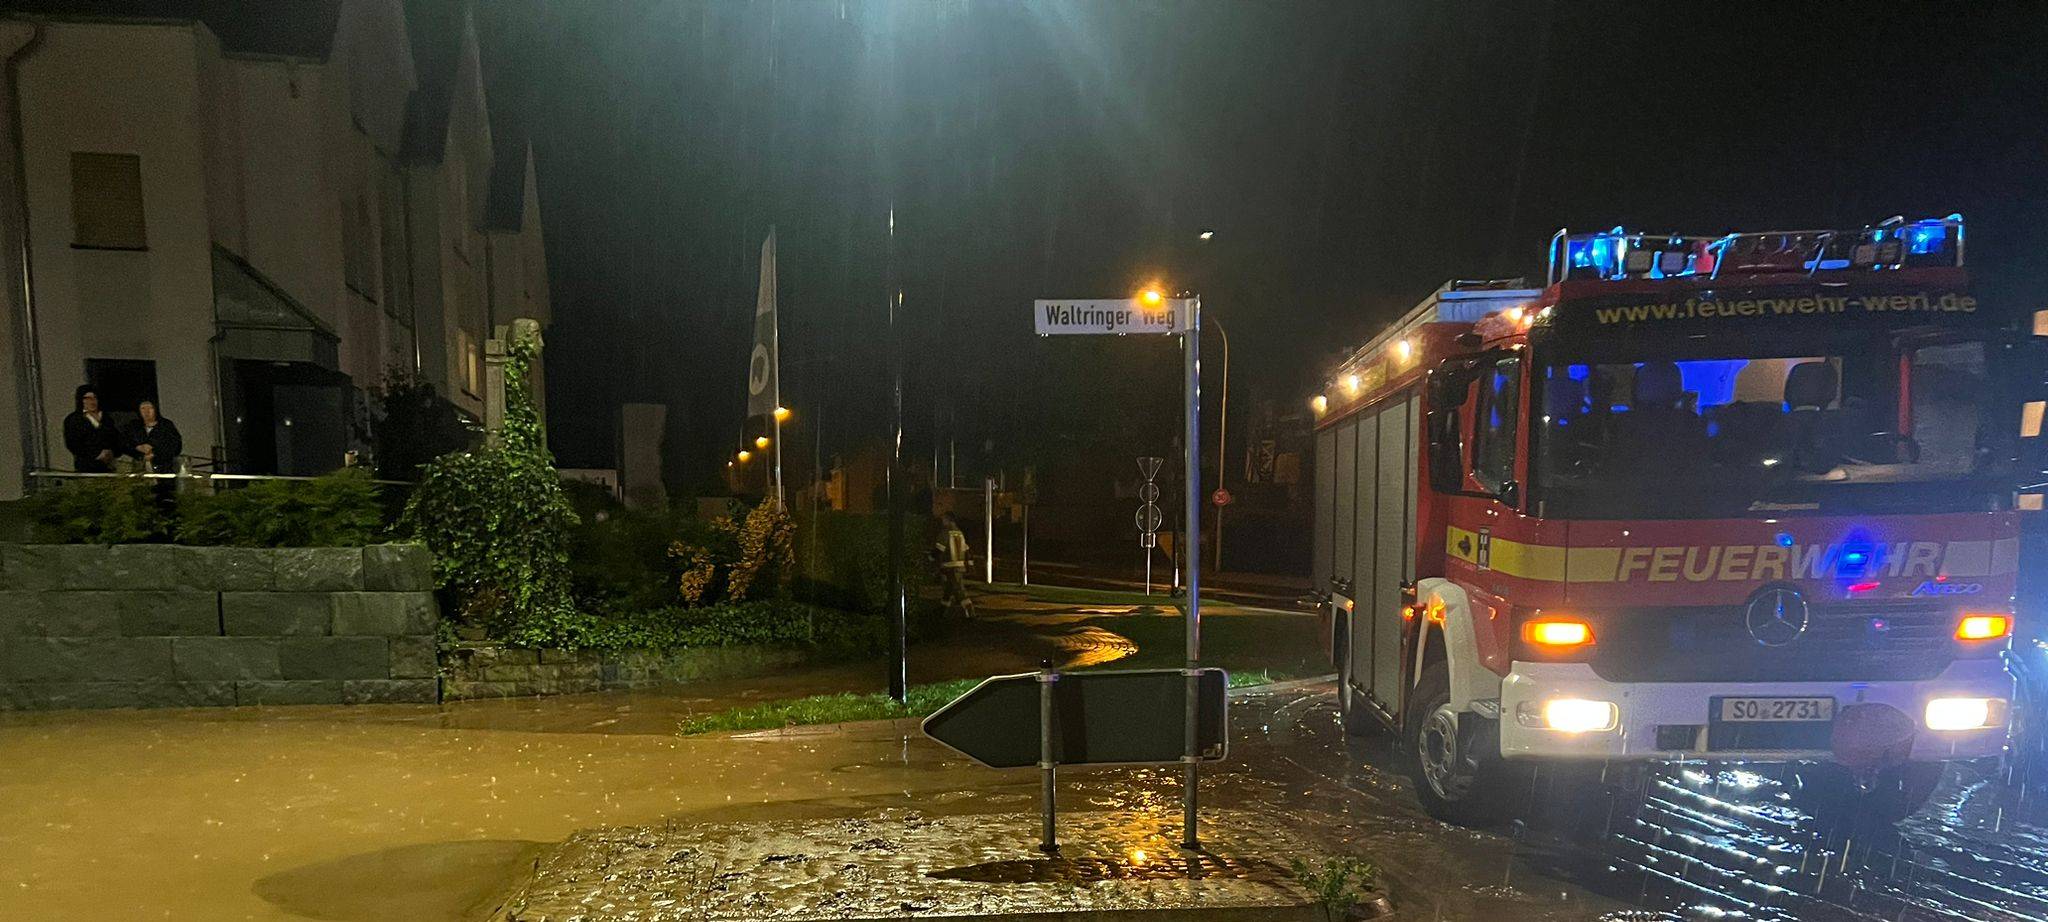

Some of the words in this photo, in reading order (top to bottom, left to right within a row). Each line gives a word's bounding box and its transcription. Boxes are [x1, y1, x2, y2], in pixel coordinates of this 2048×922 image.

[1045, 305, 1132, 331] Waltringer
[1618, 542, 1943, 581] FEUERWEHR
[1733, 700, 1758, 719] SO
[1773, 700, 1821, 719] 2731
